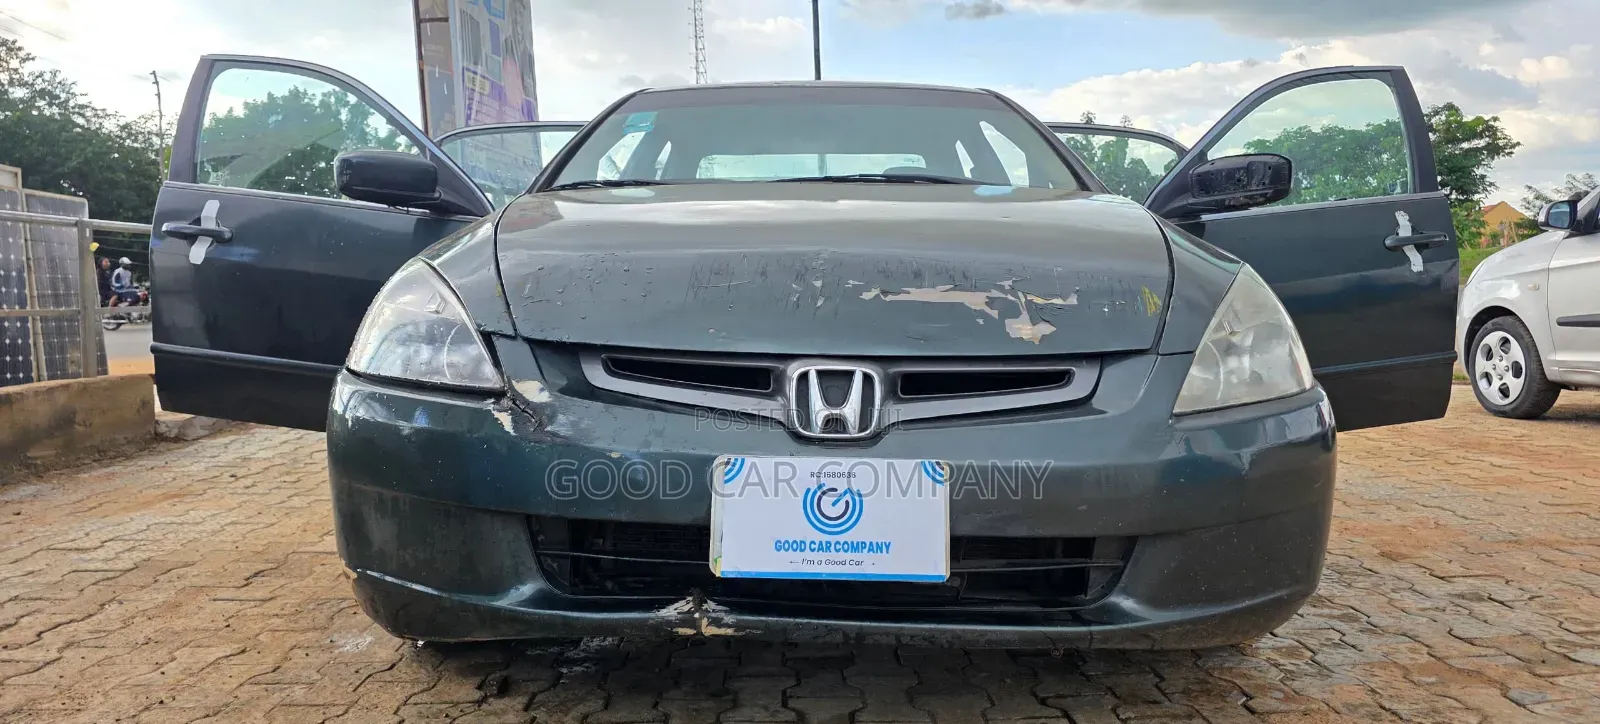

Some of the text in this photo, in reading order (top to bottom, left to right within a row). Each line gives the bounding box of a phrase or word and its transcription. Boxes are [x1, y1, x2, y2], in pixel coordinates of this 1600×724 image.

[774, 540, 892, 554] GOOD CAR COMPANY
